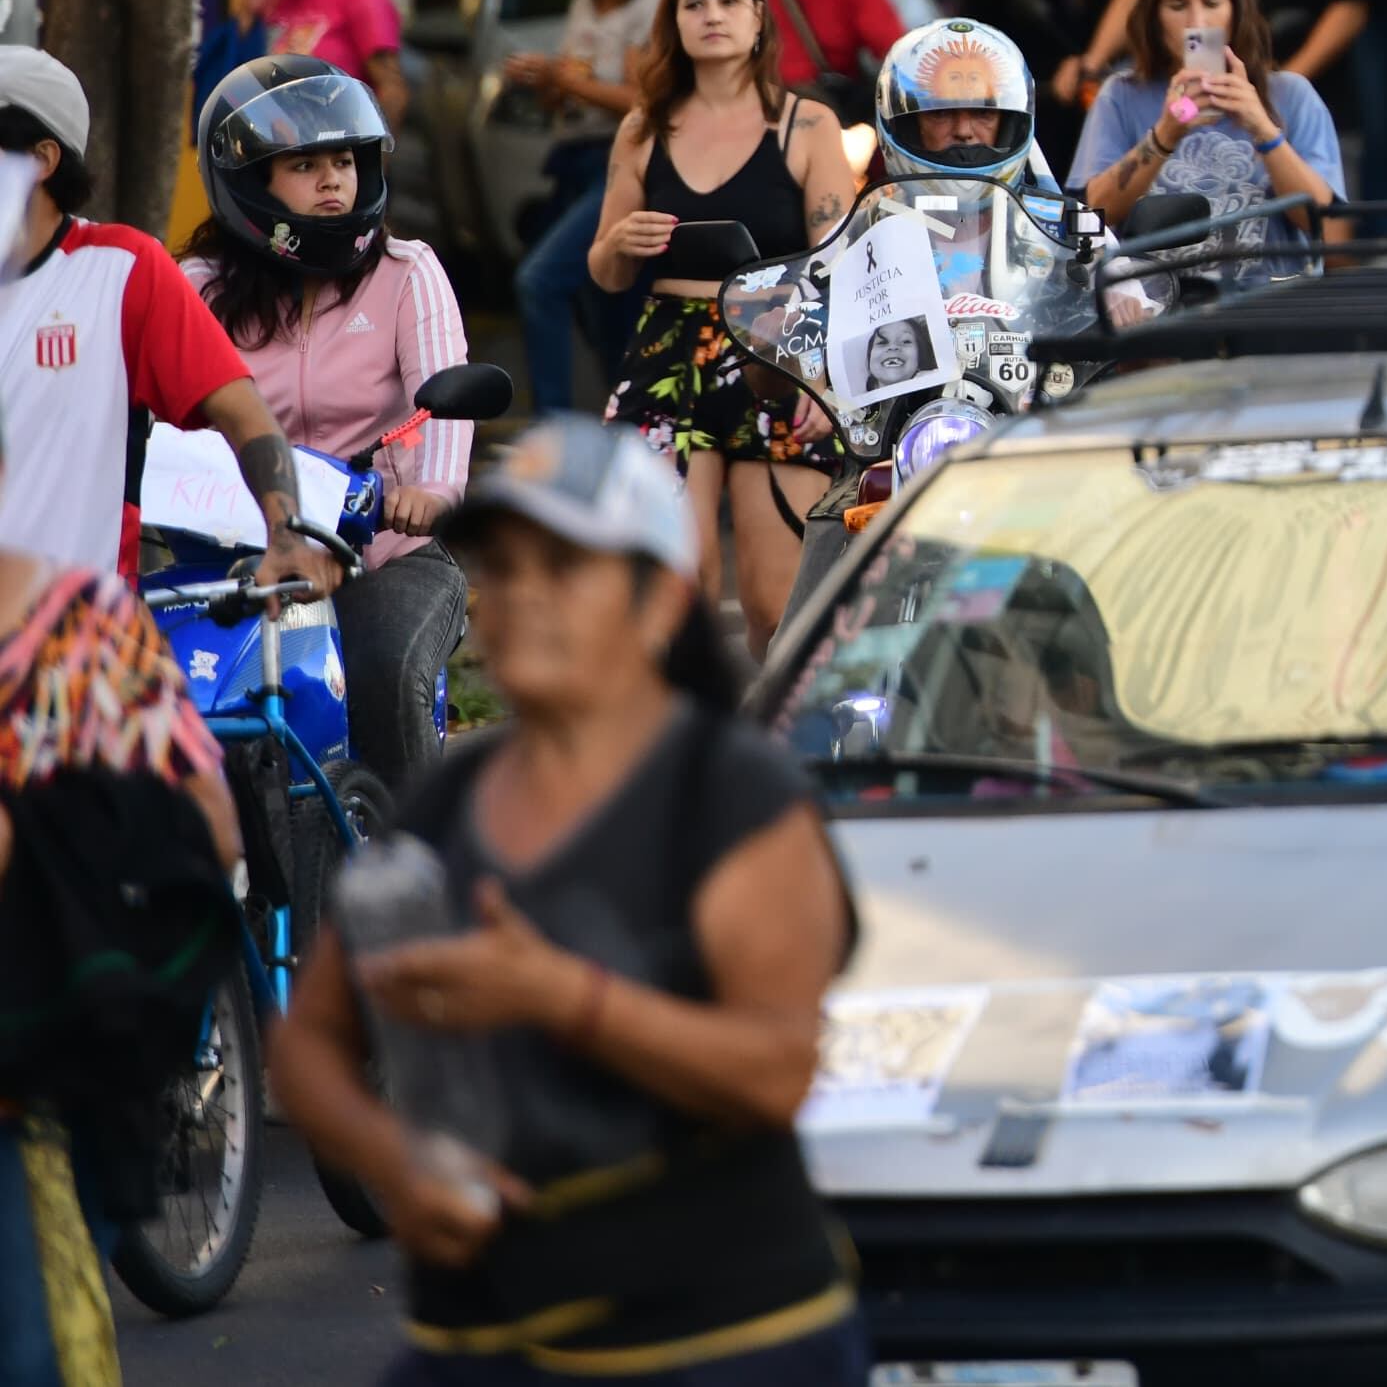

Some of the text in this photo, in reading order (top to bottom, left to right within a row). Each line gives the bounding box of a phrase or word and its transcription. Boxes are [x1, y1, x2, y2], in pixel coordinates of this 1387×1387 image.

[854, 266, 903, 303] JUSTICIA
[868, 288, 889, 310] POR
[869, 303, 893, 325] KIM
[998, 362, 1030, 382] 60
